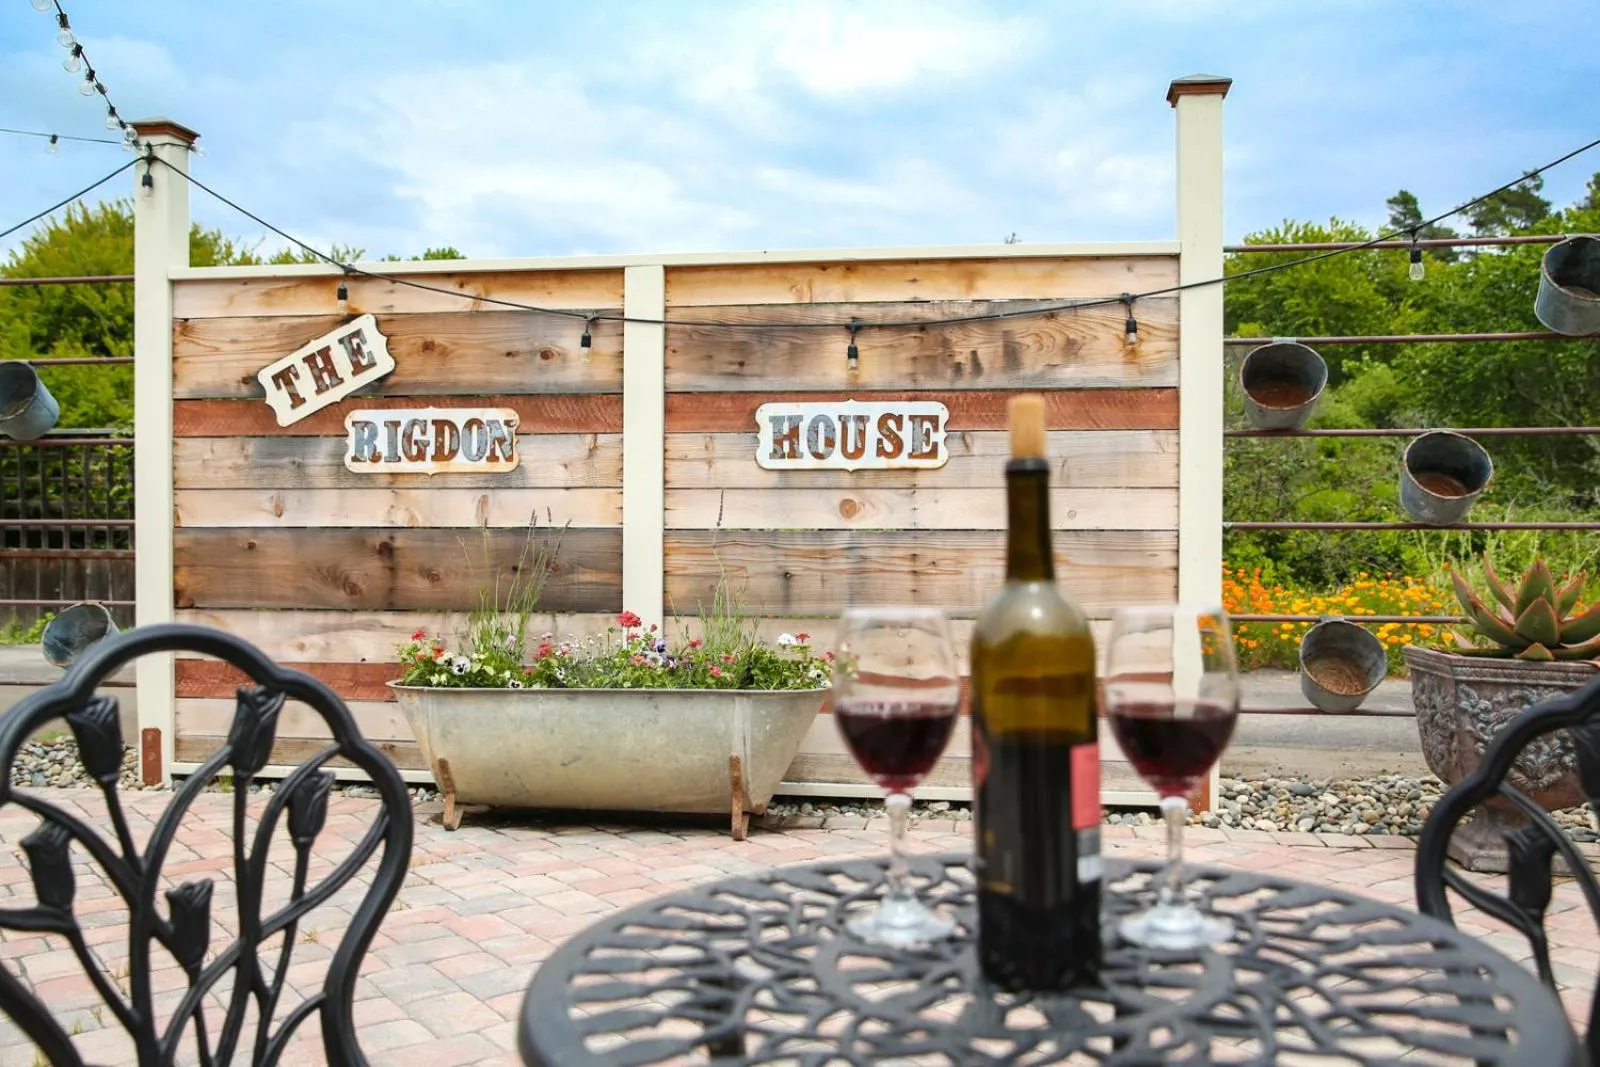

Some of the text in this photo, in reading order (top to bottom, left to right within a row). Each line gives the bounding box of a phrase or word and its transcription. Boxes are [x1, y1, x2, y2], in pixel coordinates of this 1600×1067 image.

[271, 328, 377, 410] THE
[351, 418, 514, 463] RIGDON
[768, 412, 941, 461] HOUSE
